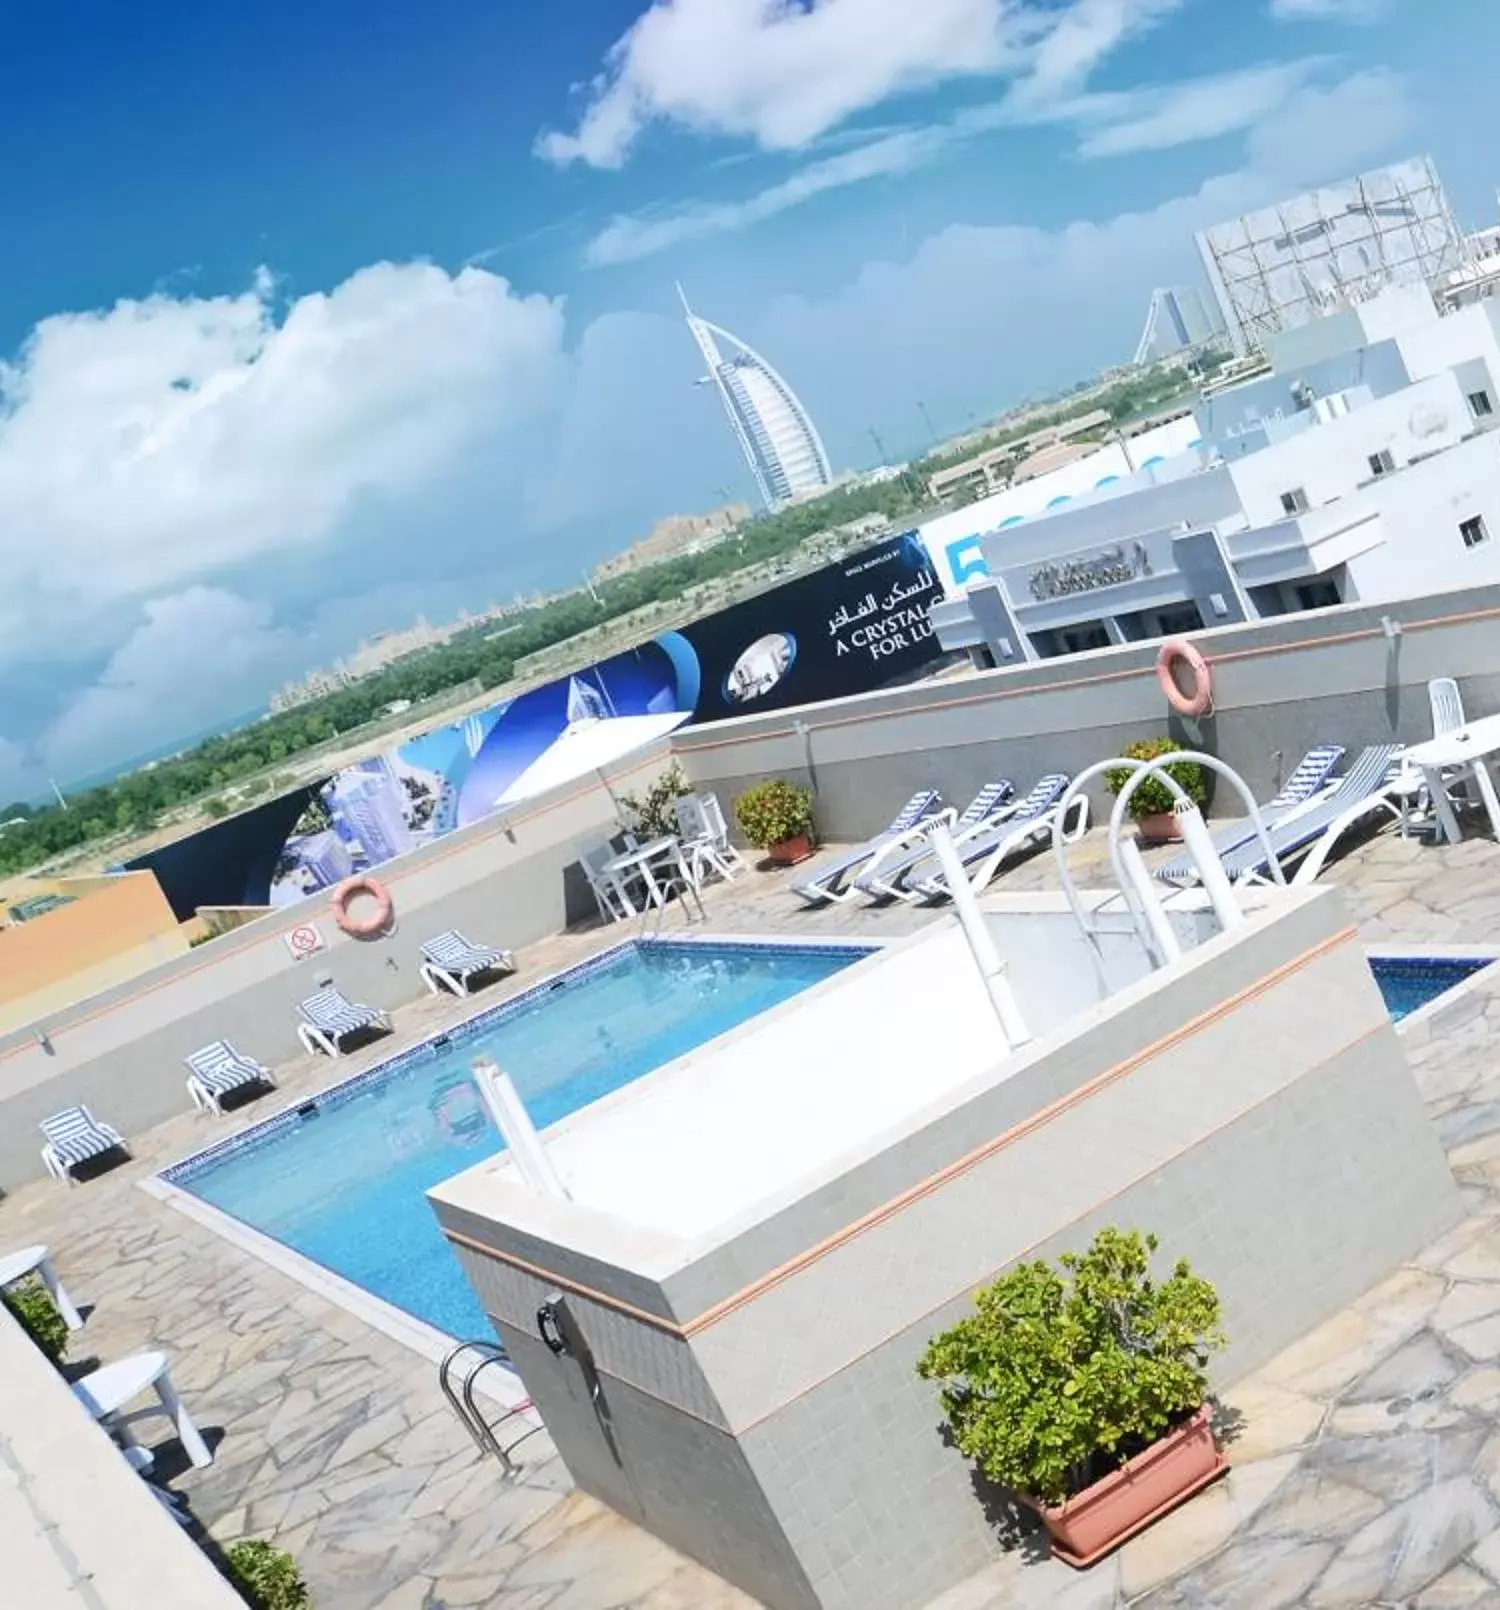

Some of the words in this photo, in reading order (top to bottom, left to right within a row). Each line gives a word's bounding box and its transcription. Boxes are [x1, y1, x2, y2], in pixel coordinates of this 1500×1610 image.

[882, 570, 933, 610] للسكن
[837, 639, 850, 656] A
[851, 604, 928, 647] CRYSTAL
[870, 633, 909, 660] FOR
[911, 620, 933, 642] LU
